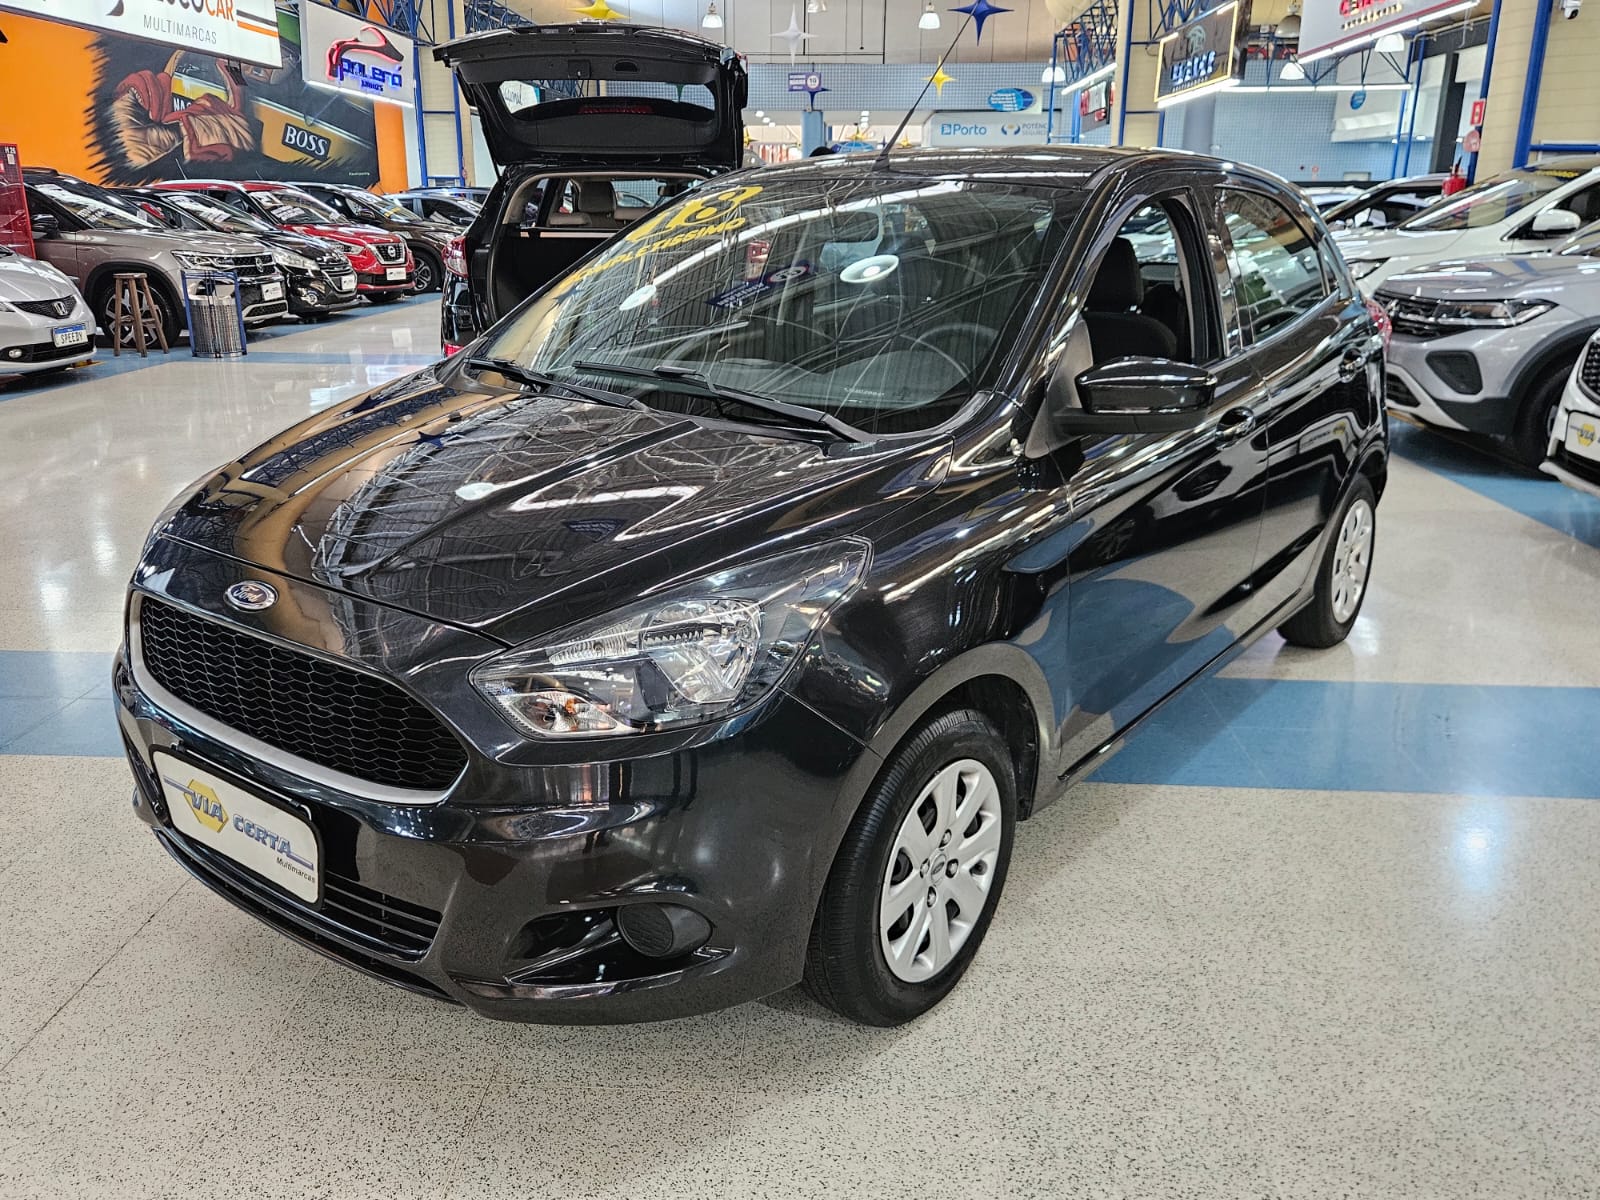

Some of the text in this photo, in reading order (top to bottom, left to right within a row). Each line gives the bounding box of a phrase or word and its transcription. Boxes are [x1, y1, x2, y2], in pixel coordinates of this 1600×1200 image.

[143, 14, 217, 45] MULTIMARCAS
[285, 125, 328, 156] BOSS
[953, 123, 987, 136] Porto
[61, 331, 82, 344] SPEEDY
[232, 584, 264, 603] Ford
[191, 791, 292, 857] VIA CERTA
[276, 856, 316, 884] Multimarcas
